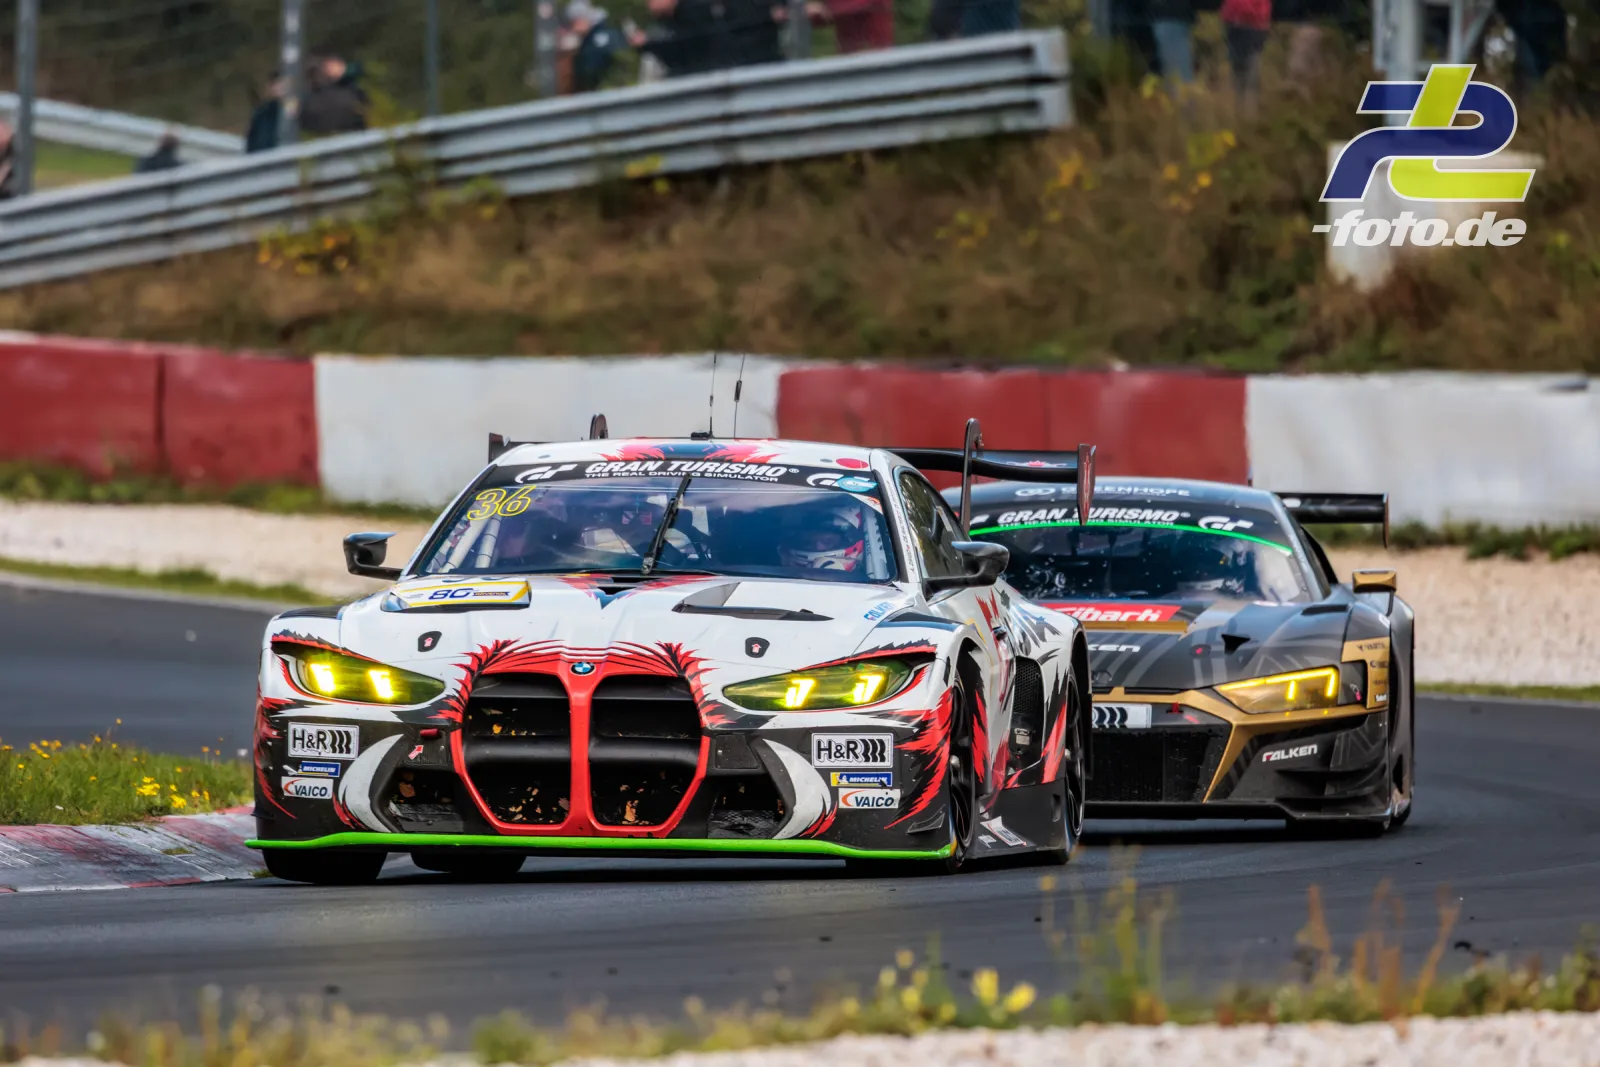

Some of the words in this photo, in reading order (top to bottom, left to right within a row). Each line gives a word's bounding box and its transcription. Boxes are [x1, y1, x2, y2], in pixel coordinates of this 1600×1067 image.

[585, 460, 664, 473] GRAN
[704, 472, 778, 482] SIMULATOR
[1061, 485, 1190, 496] GEENHOPE
[466, 485, 537, 520] 36
[997, 508, 1068, 524] GRAN
[293, 728, 328, 753] H&R
[816, 739, 861, 763] H&R
[1262, 744, 1318, 763] FALKEN
[294, 785, 328, 797] VAICO
[855, 796, 895, 808] VAICO
